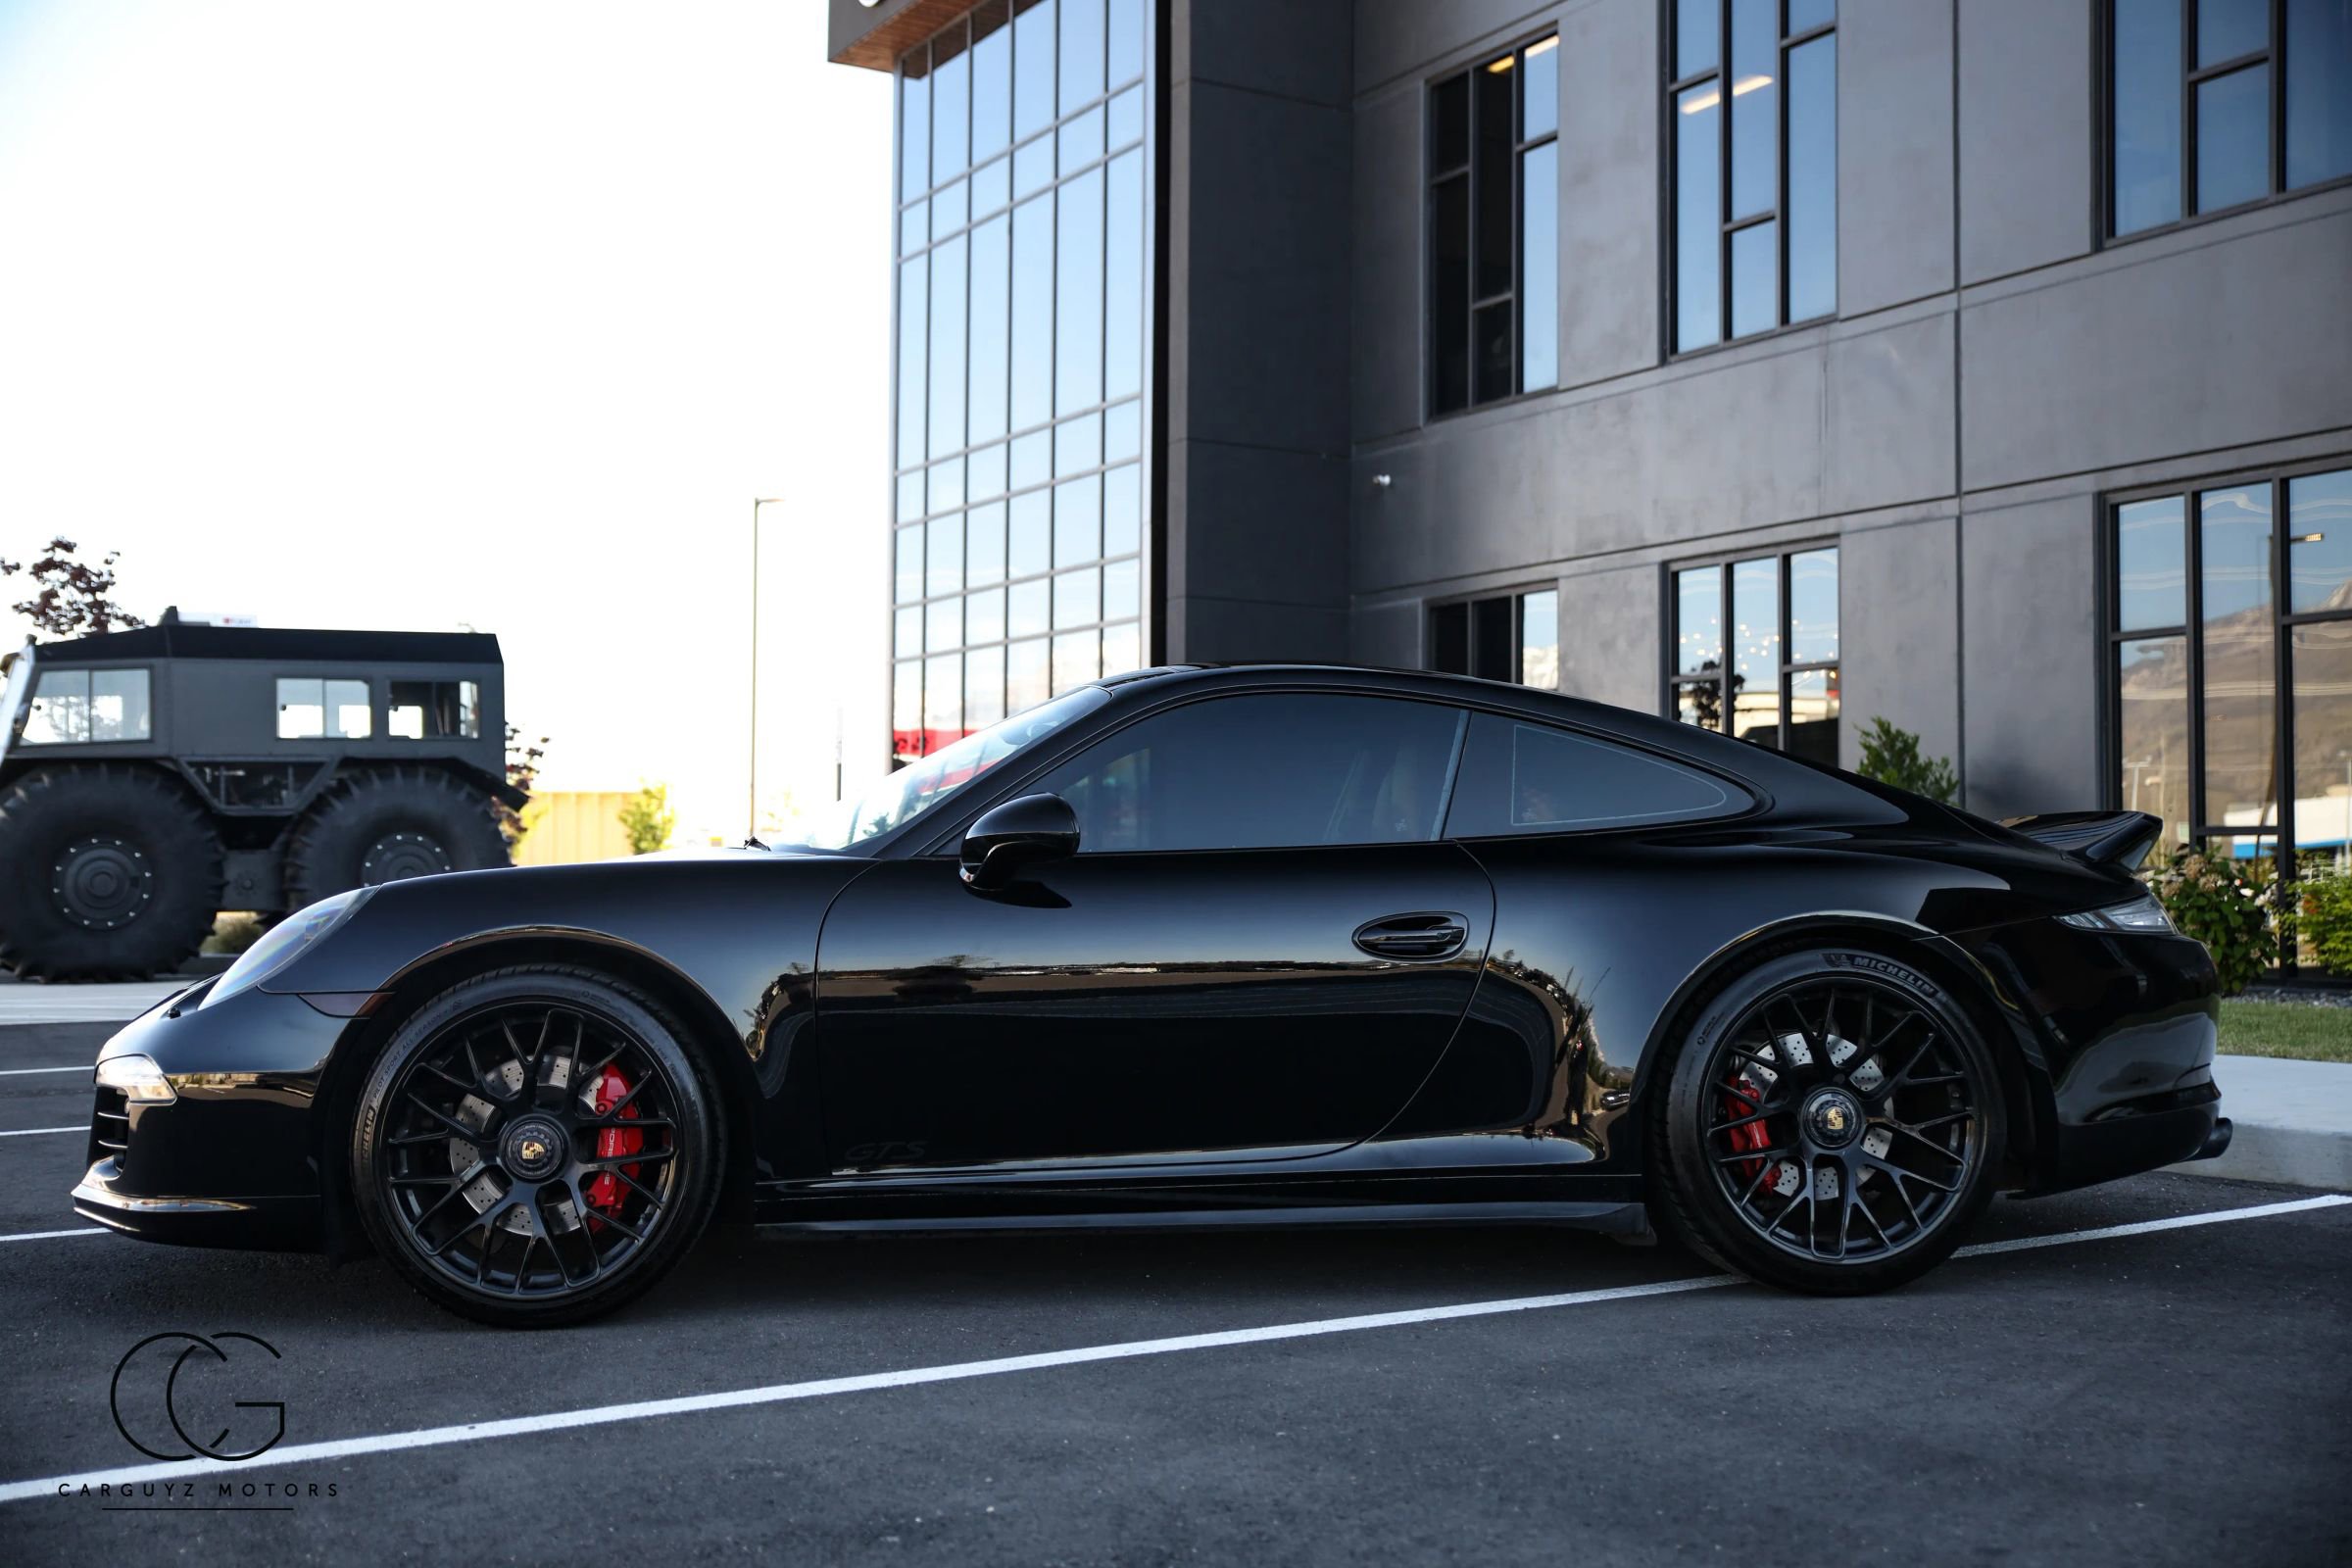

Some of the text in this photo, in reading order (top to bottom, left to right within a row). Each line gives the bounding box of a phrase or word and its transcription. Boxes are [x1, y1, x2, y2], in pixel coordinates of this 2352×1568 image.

[1853, 956, 1936, 996] MICHELIN
[373, 1076, 386, 1099] PILOT
[384, 1050, 401, 1075] SPORT
[844, 1141, 929, 1161] GTS
